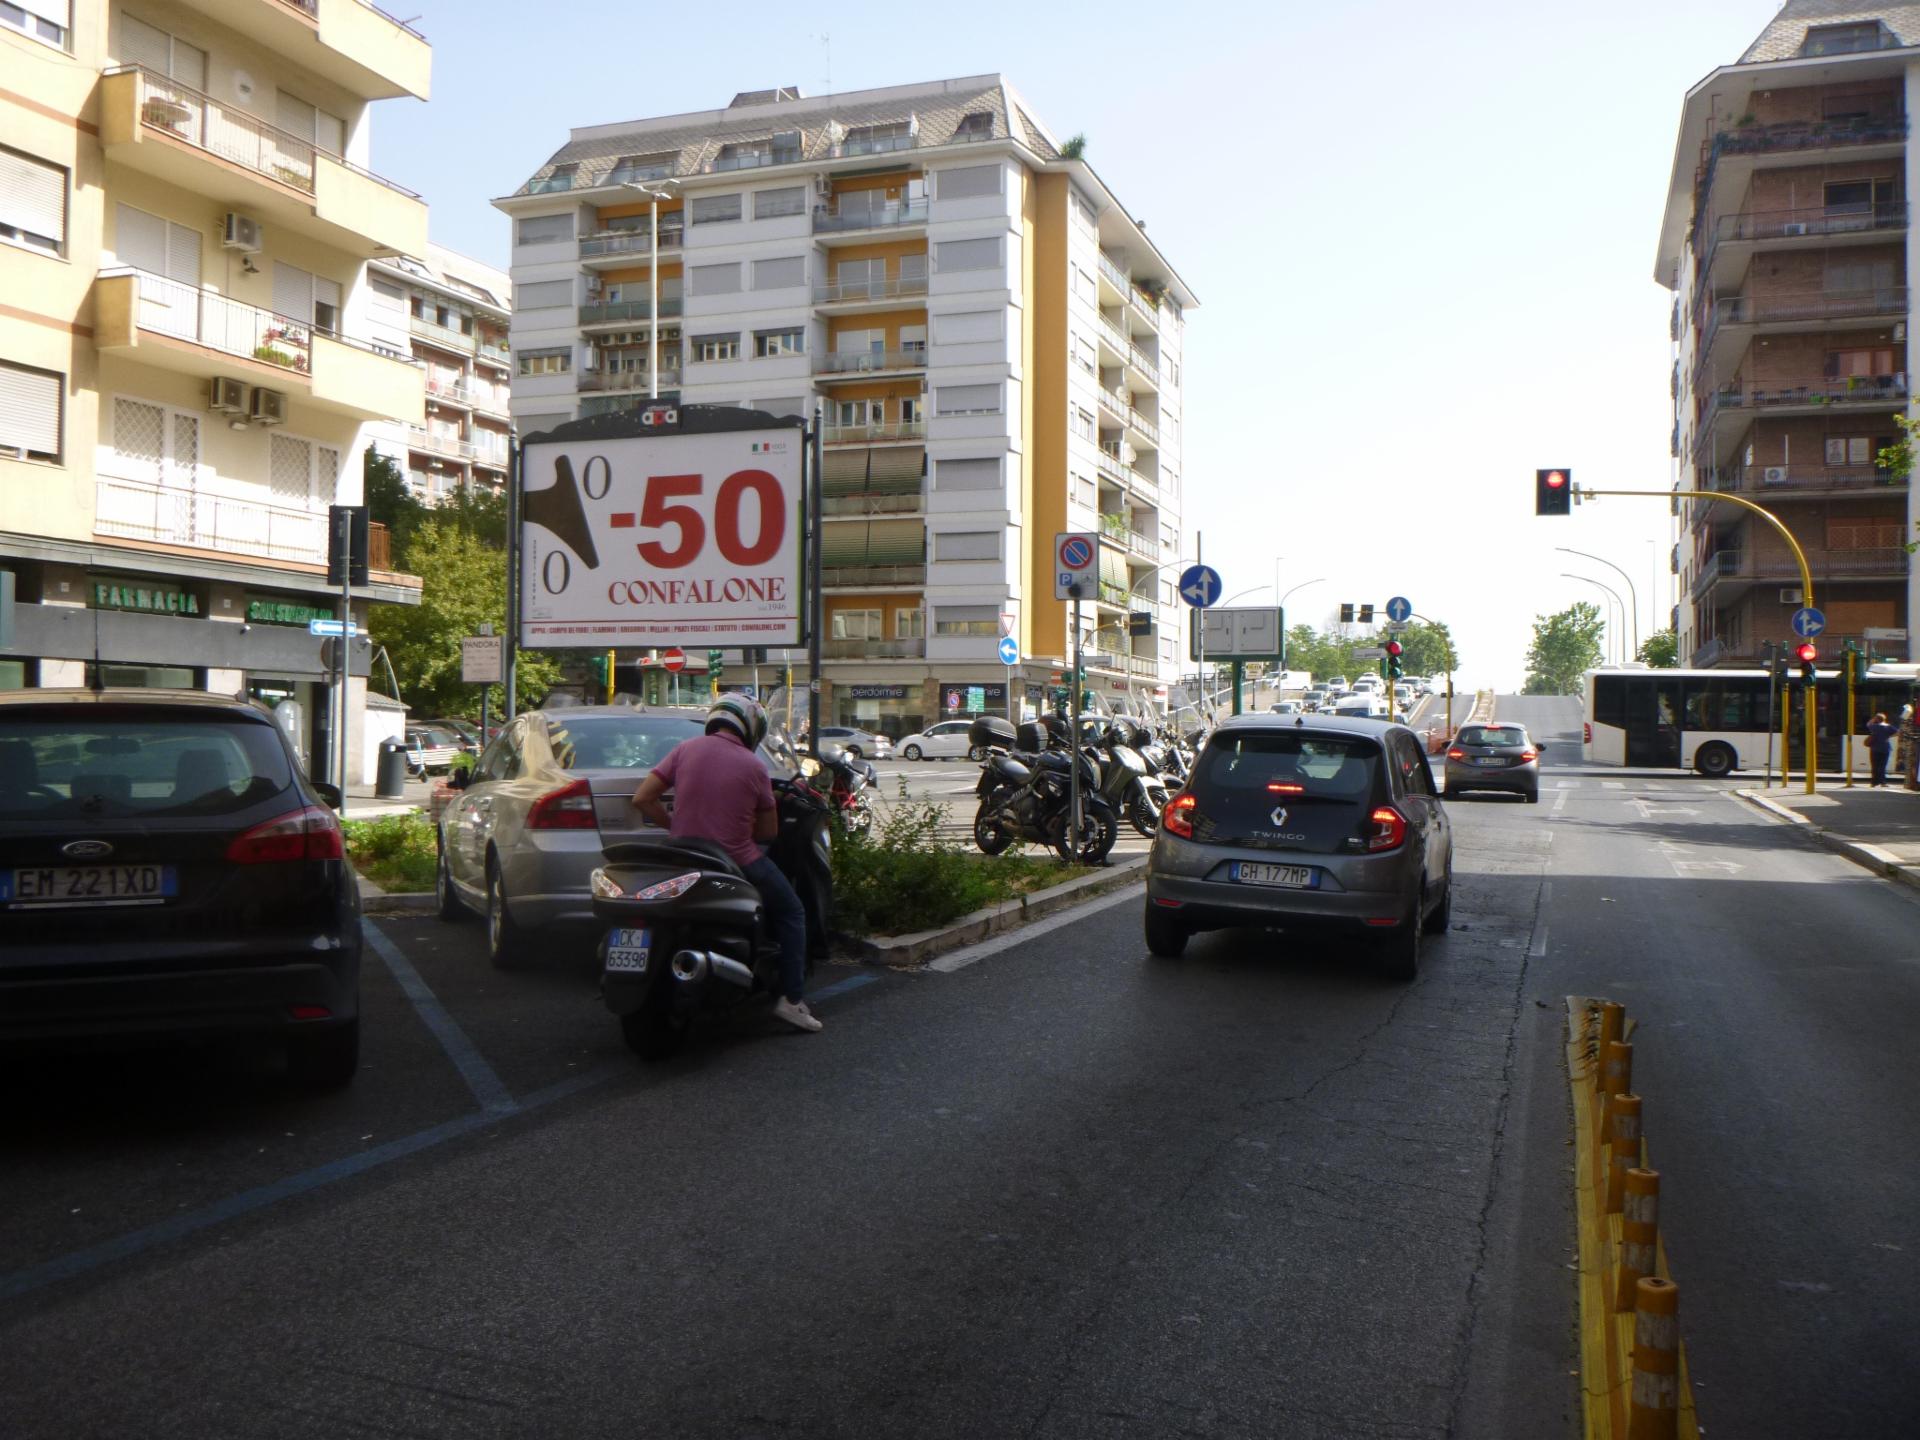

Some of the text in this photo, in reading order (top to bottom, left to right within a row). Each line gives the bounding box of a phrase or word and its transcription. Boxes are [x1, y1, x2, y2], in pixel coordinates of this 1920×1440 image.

[96, 584, 199, 613] FARMACIA
[608, 577, 786, 605] CONFALONE
[851, 686, 903, 699] perdormire
[1251, 831, 1305, 840] TWINGO
[18, 870, 54, 898] EM
[67, 867, 158, 896] 221XD
[1240, 864, 1258, 879] GH
[1265, 867, 1309, 883] 177MP
[608, 951, 646, 968] 63398
